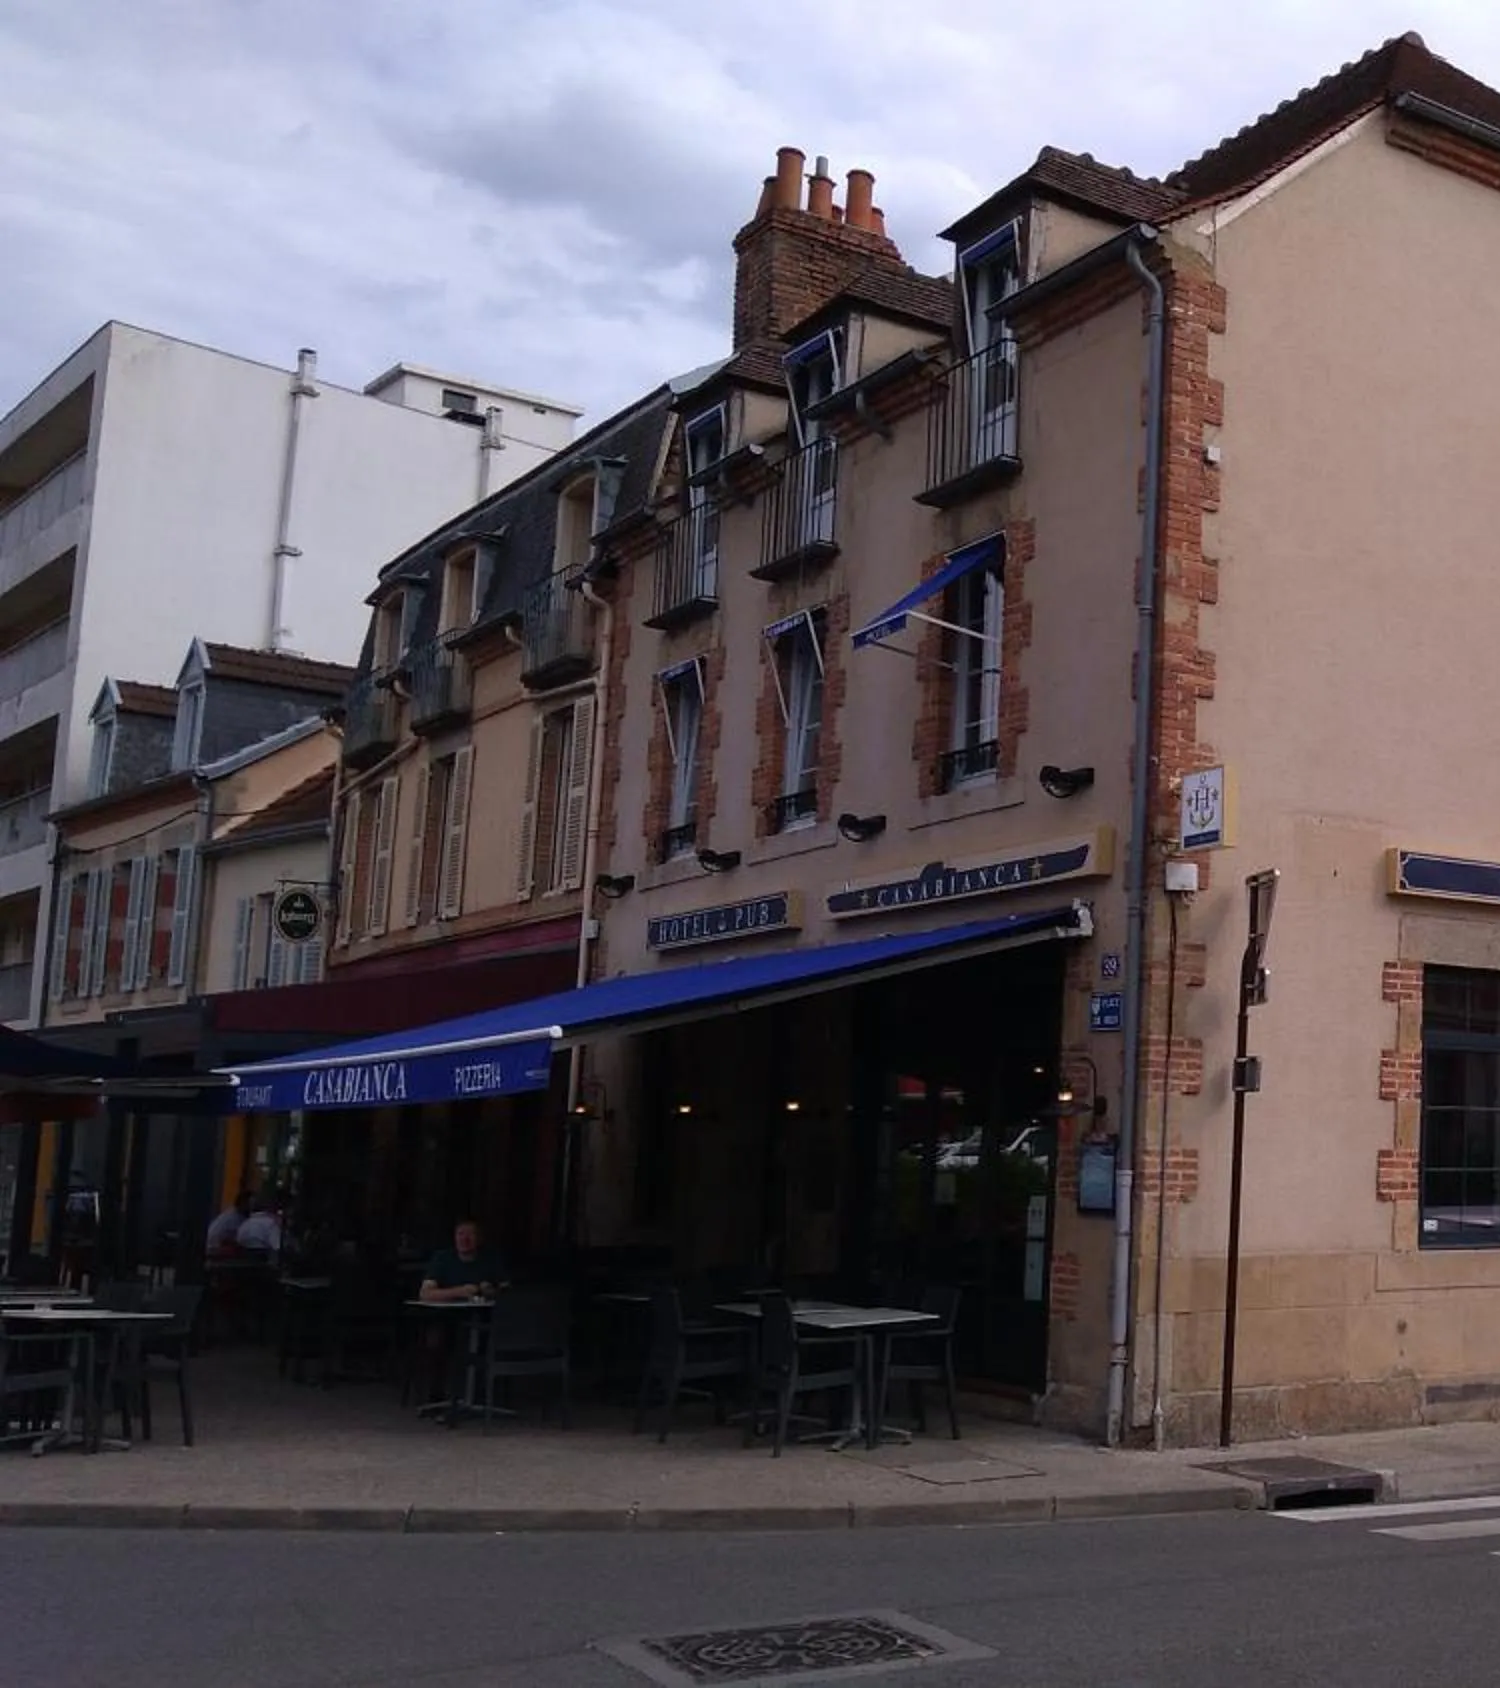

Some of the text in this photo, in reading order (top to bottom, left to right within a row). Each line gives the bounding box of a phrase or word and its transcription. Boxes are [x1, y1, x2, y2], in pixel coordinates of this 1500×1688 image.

[878, 864, 1021, 907] CASABIANCA
[659, 902, 769, 942] HOTEL PUB
[304, 1062, 407, 1104] CASABIANCA
[455, 1062, 500, 1093] PIZZERIA
